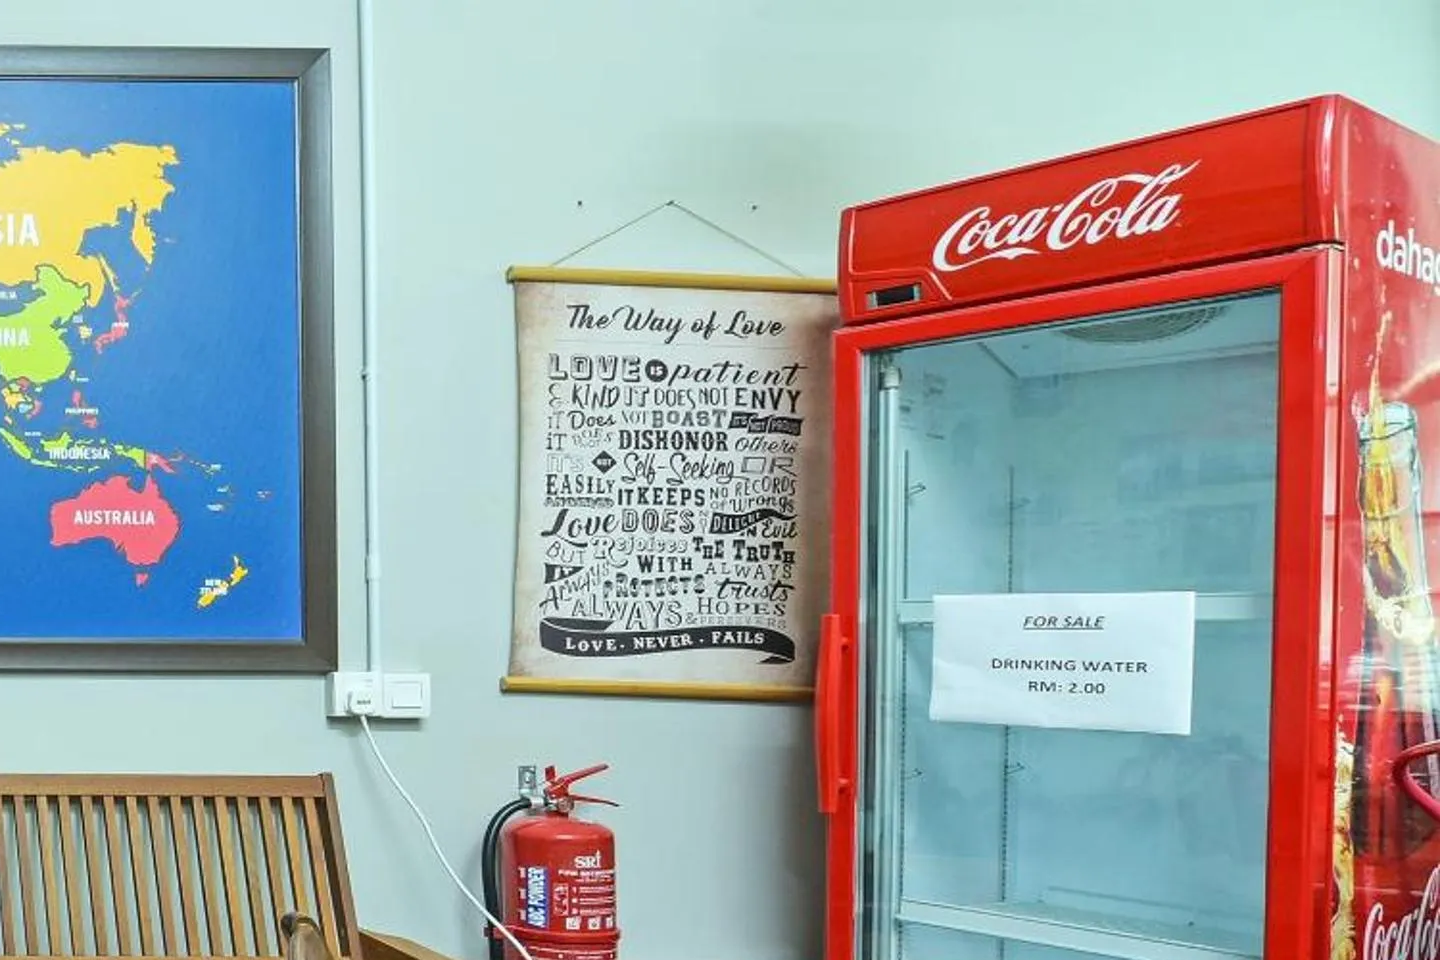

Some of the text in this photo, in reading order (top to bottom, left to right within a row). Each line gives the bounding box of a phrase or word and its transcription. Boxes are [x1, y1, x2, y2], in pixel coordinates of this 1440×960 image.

[932, 160, 1201, 272] Coca-Cola
[566, 304, 786, 344] The Way of Love
[548, 353, 641, 382] LOVE
[668, 360, 808, 386] patient
[572, 383, 620, 410] KIND
[654, 387, 696, 409] DOES
[698, 386, 728, 406] NOT
[735, 387, 802, 414] ENVY
[567, 410, 617, 430] Does
[652, 410, 727, 428] BOAST
[618, 430, 728, 451] DISHONOR
[48, 448, 111, 461] INDONESIA
[620, 452, 749, 485] Self-Seeking
[546, 473, 615, 495] EASILY
[618, 488, 634, 506] IT
[637, 486, 706, 507] KEEPS
[74, 510, 155, 526] AUSTRALIA
[540, 508, 619, 548] Love
[621, 508, 696, 534] DOES
[546, 541, 586, 563] BUT
[693, 536, 724, 559] THE
[733, 539, 796, 563] TRUTH
[637, 554, 693, 573] WITH
[704, 562, 792, 580] ALWAYS
[603, 572, 705, 598] PROTECTS
[715, 577, 795, 601] trusts
[572, 594, 683, 630] ALWAYS
[697, 597, 786, 617] HOPES
[1023, 615, 1106, 629] FOR SALE
[633, 634, 694, 650] NEVER
[712, 631, 766, 646] FAILS
[992, 657, 1148, 673] DRINKING WATER
[1028, 680, 1105, 694] RM: 2.00
